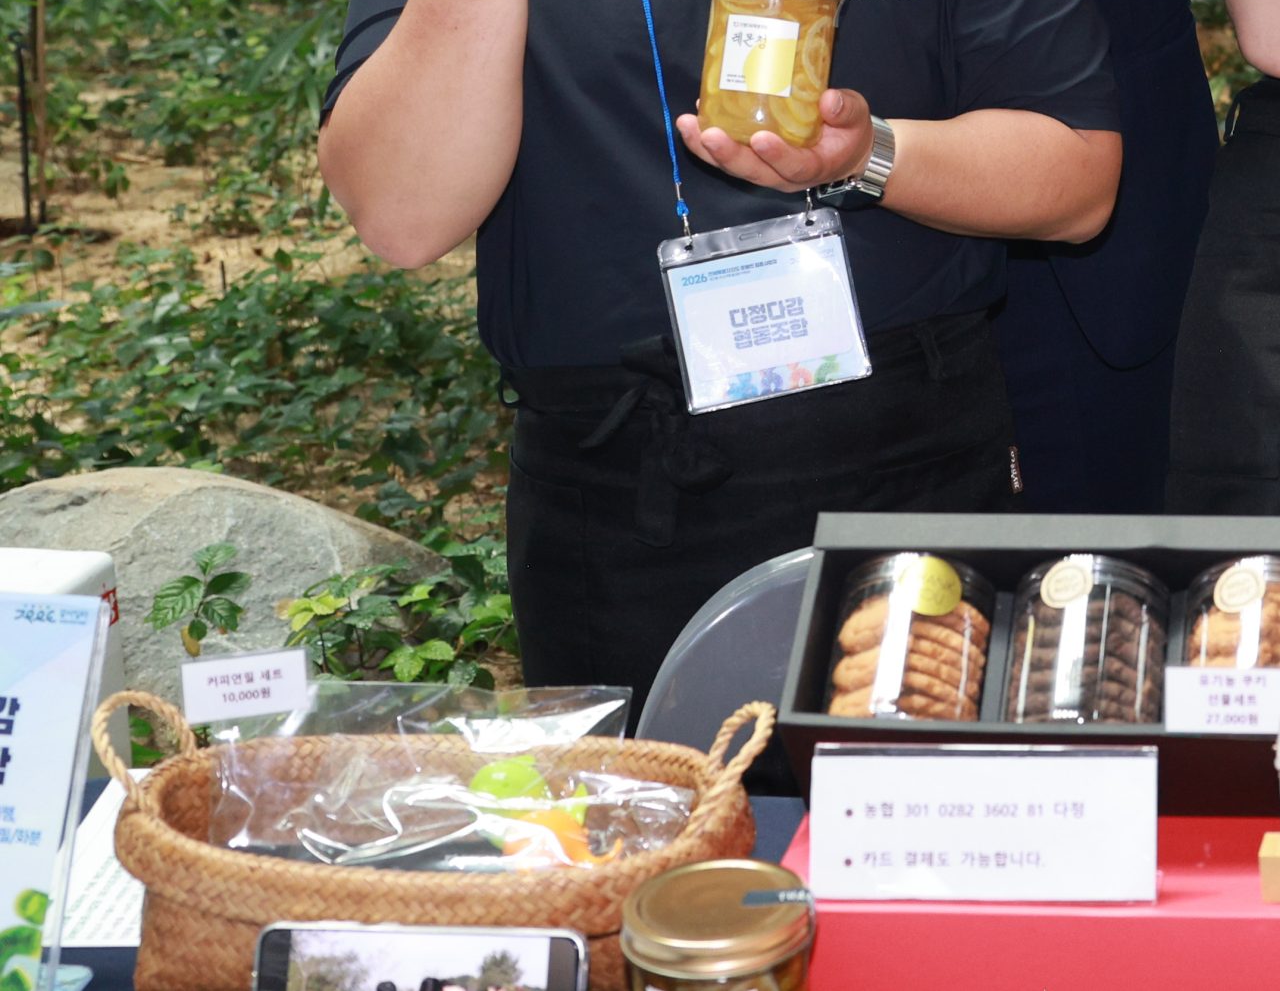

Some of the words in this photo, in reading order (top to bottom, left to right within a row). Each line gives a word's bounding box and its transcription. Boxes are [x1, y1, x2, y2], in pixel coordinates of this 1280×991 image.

[681, 273, 708, 287] 2026
[728, 296, 805, 329] 다정다감
[733, 317, 809, 350] 협동조합
[207, 671, 254, 687] 커피연필
[261, 668, 283, 681] 세트
[222, 687, 271, 703] 10,000원
[864, 802, 895, 818] 농협
[904, 803, 930, 818] 301
[937, 803, 975, 818] 0282
[983, 803, 1019, 818] 3602
[1026, 803, 1044, 817] 81
[1053, 802, 1085, 819] 다정
[863, 851, 893, 868] 카드
[905, 851, 950, 868] 결제도
[961, 851, 1045, 869] 가능합니다.
